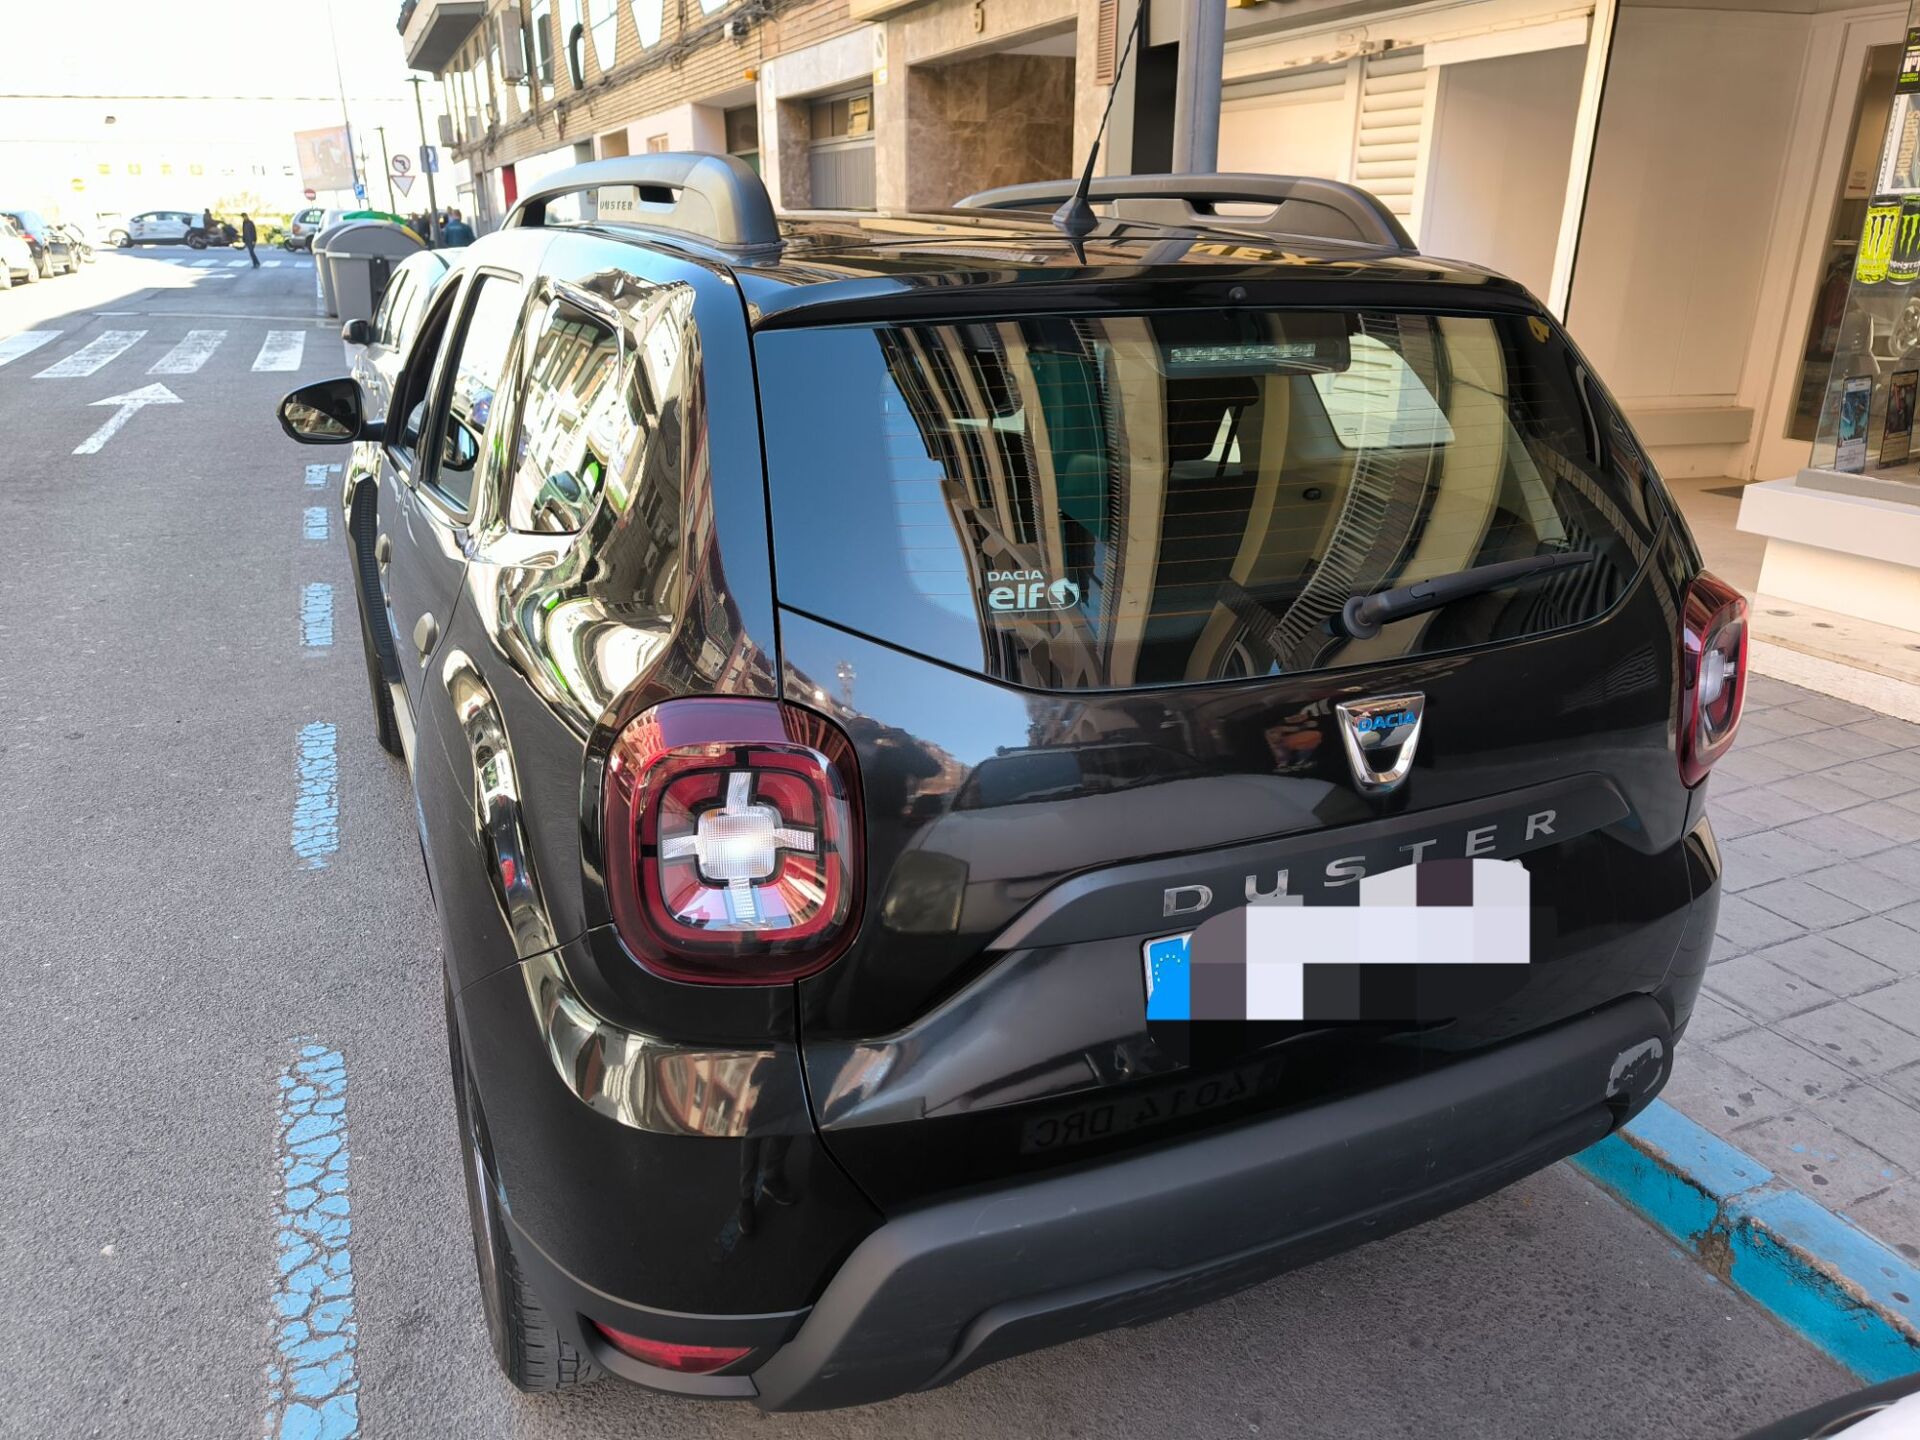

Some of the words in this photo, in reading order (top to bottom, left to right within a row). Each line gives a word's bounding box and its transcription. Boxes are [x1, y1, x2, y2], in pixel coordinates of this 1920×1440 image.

[974, 0, 985, 33] 5
[599, 200, 633, 210] DUSTER
[988, 570, 1044, 582] DACIA
[988, 582, 1045, 610] elf
[1357, 711, 1416, 733] DACIA
[1163, 809, 1557, 917] DUSTER
